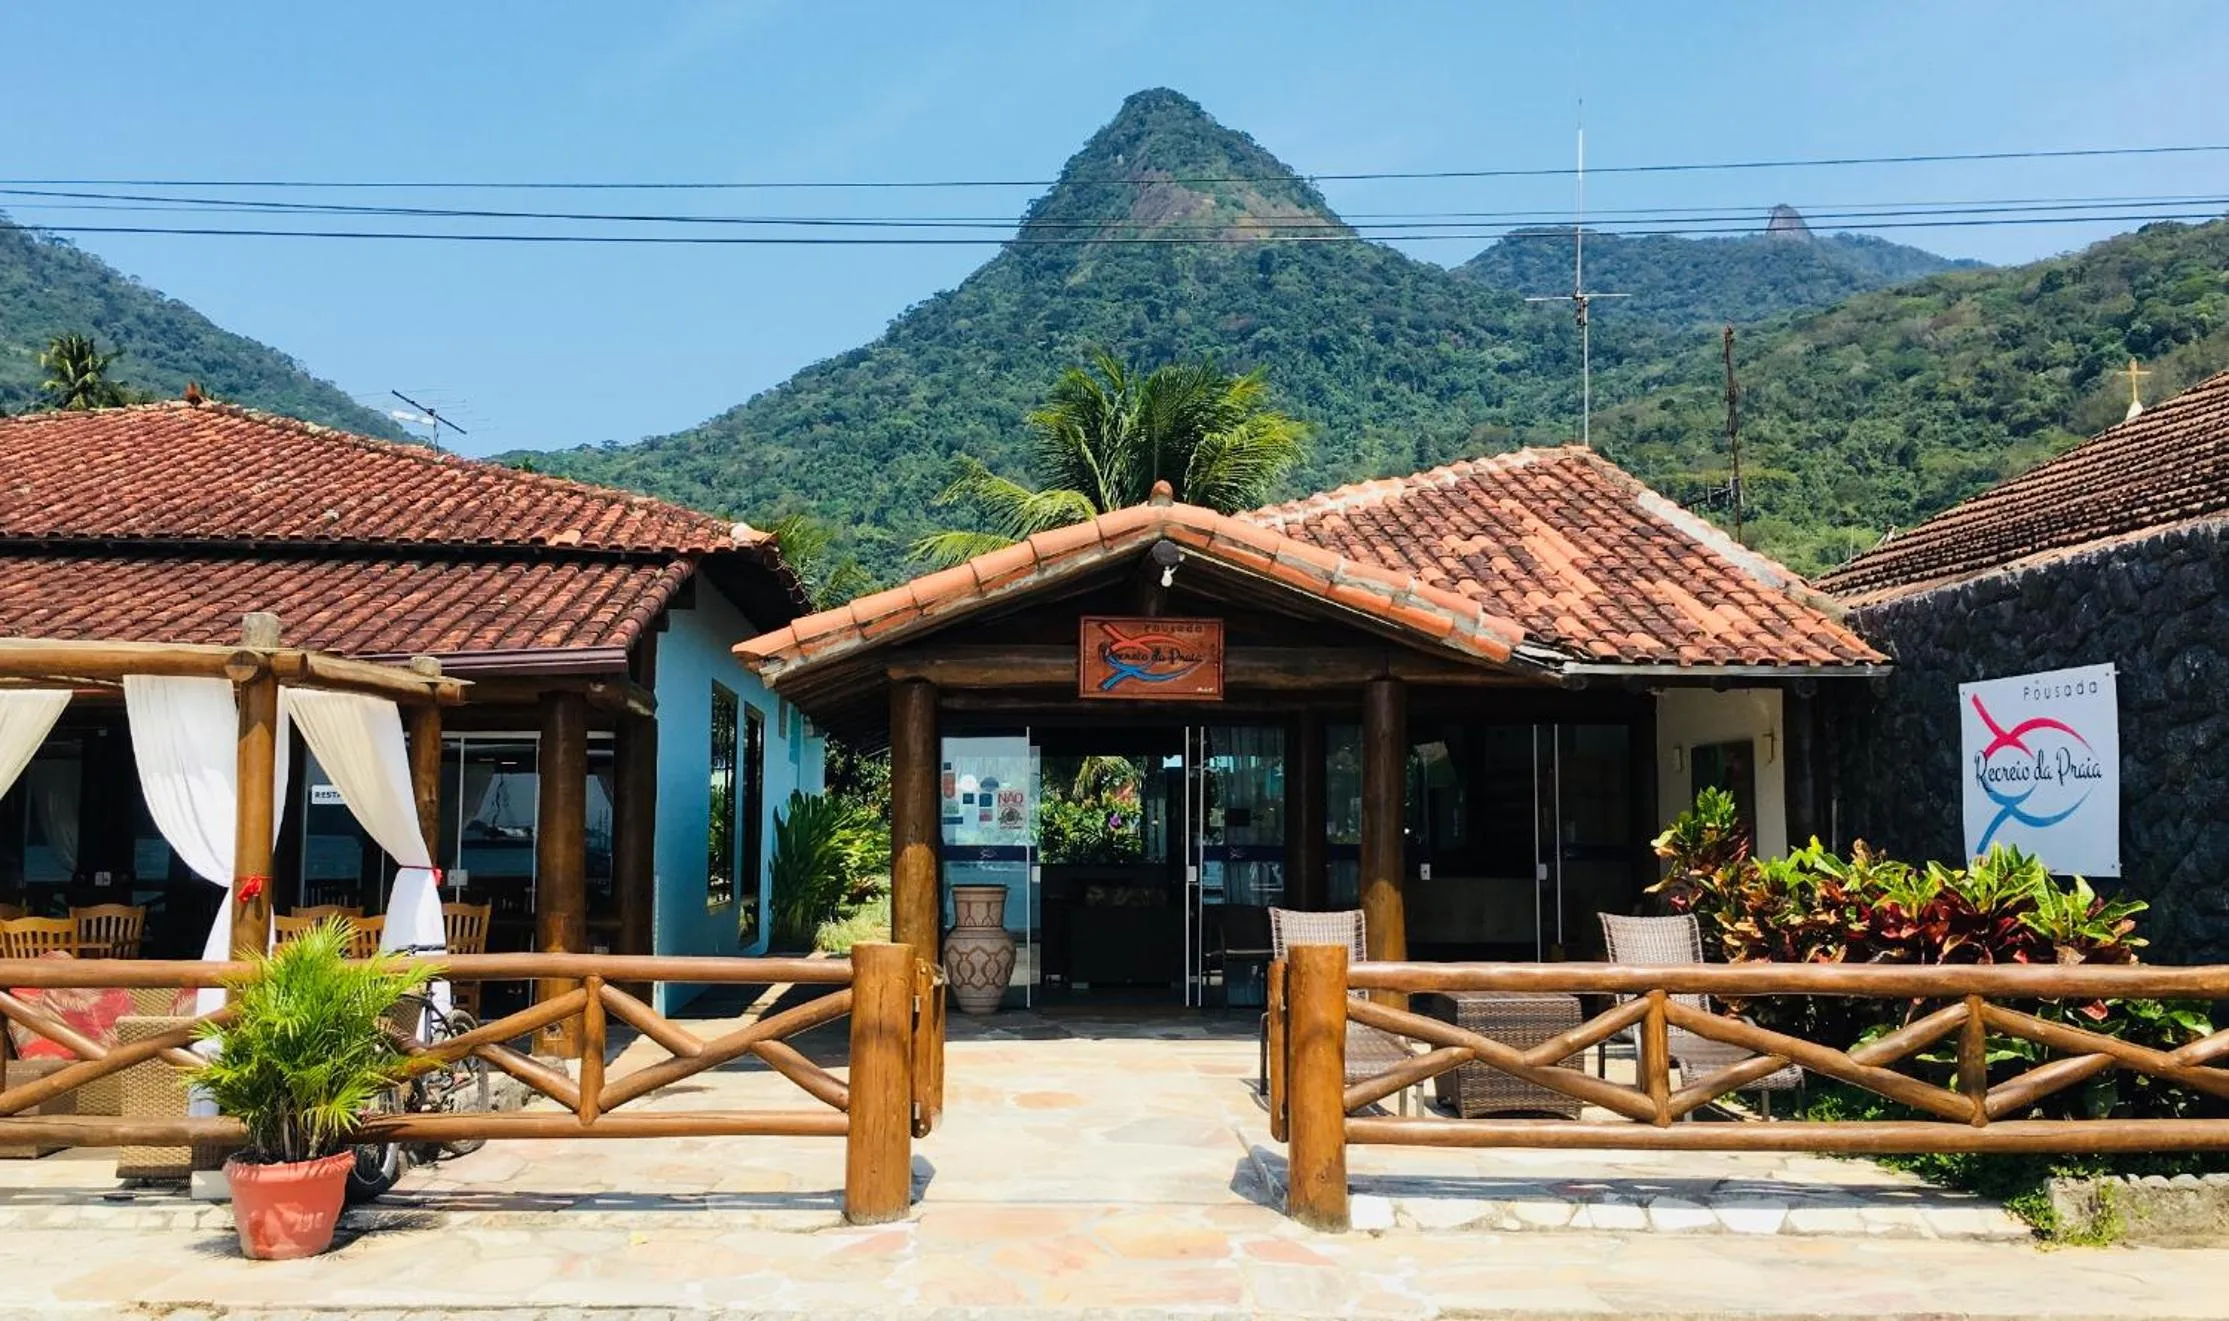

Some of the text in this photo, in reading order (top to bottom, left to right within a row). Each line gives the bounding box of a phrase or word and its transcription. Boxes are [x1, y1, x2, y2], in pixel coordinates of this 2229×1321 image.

[2023, 680, 2098, 701] Pousada
[1974, 747, 2102, 788] Recreio da Praia
